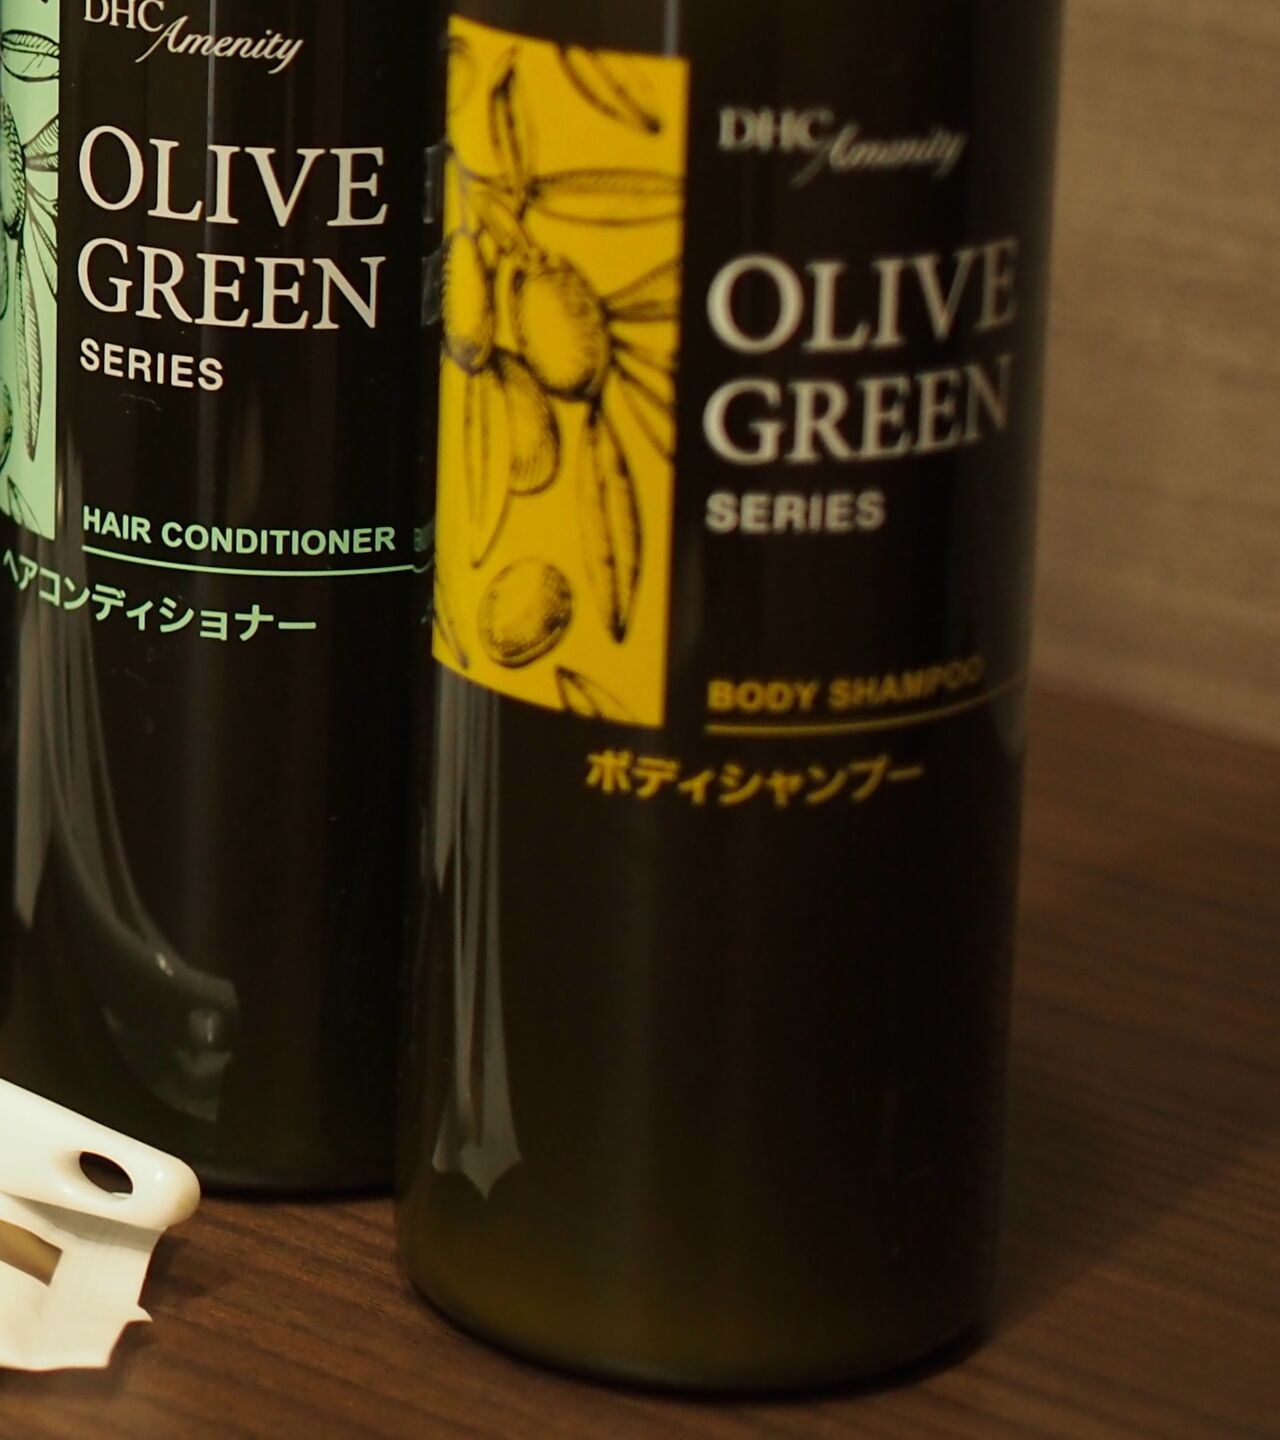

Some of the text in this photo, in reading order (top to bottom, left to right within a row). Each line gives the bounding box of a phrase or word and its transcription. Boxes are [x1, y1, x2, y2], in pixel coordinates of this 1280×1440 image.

[135, 15, 304, 75] Amenity
[718, 106, 834, 152] DHC
[78, 125, 389, 229] OLIVE
[76, 236, 387, 331] GREEN
[705, 237, 1020, 355] OLIVE
[79, 336, 225, 393] SERIES
[702, 353, 1014, 467] GREEN
[82, 504, 397, 557] HAIR CONDITIONER
[704, 490, 887, 535] SERIES
[2, 548, 318, 642] ヘアコンディショナー
[706, 655, 986, 713] BODY SHAMPOO
[584, 748, 926, 809] ボディシャンプー
